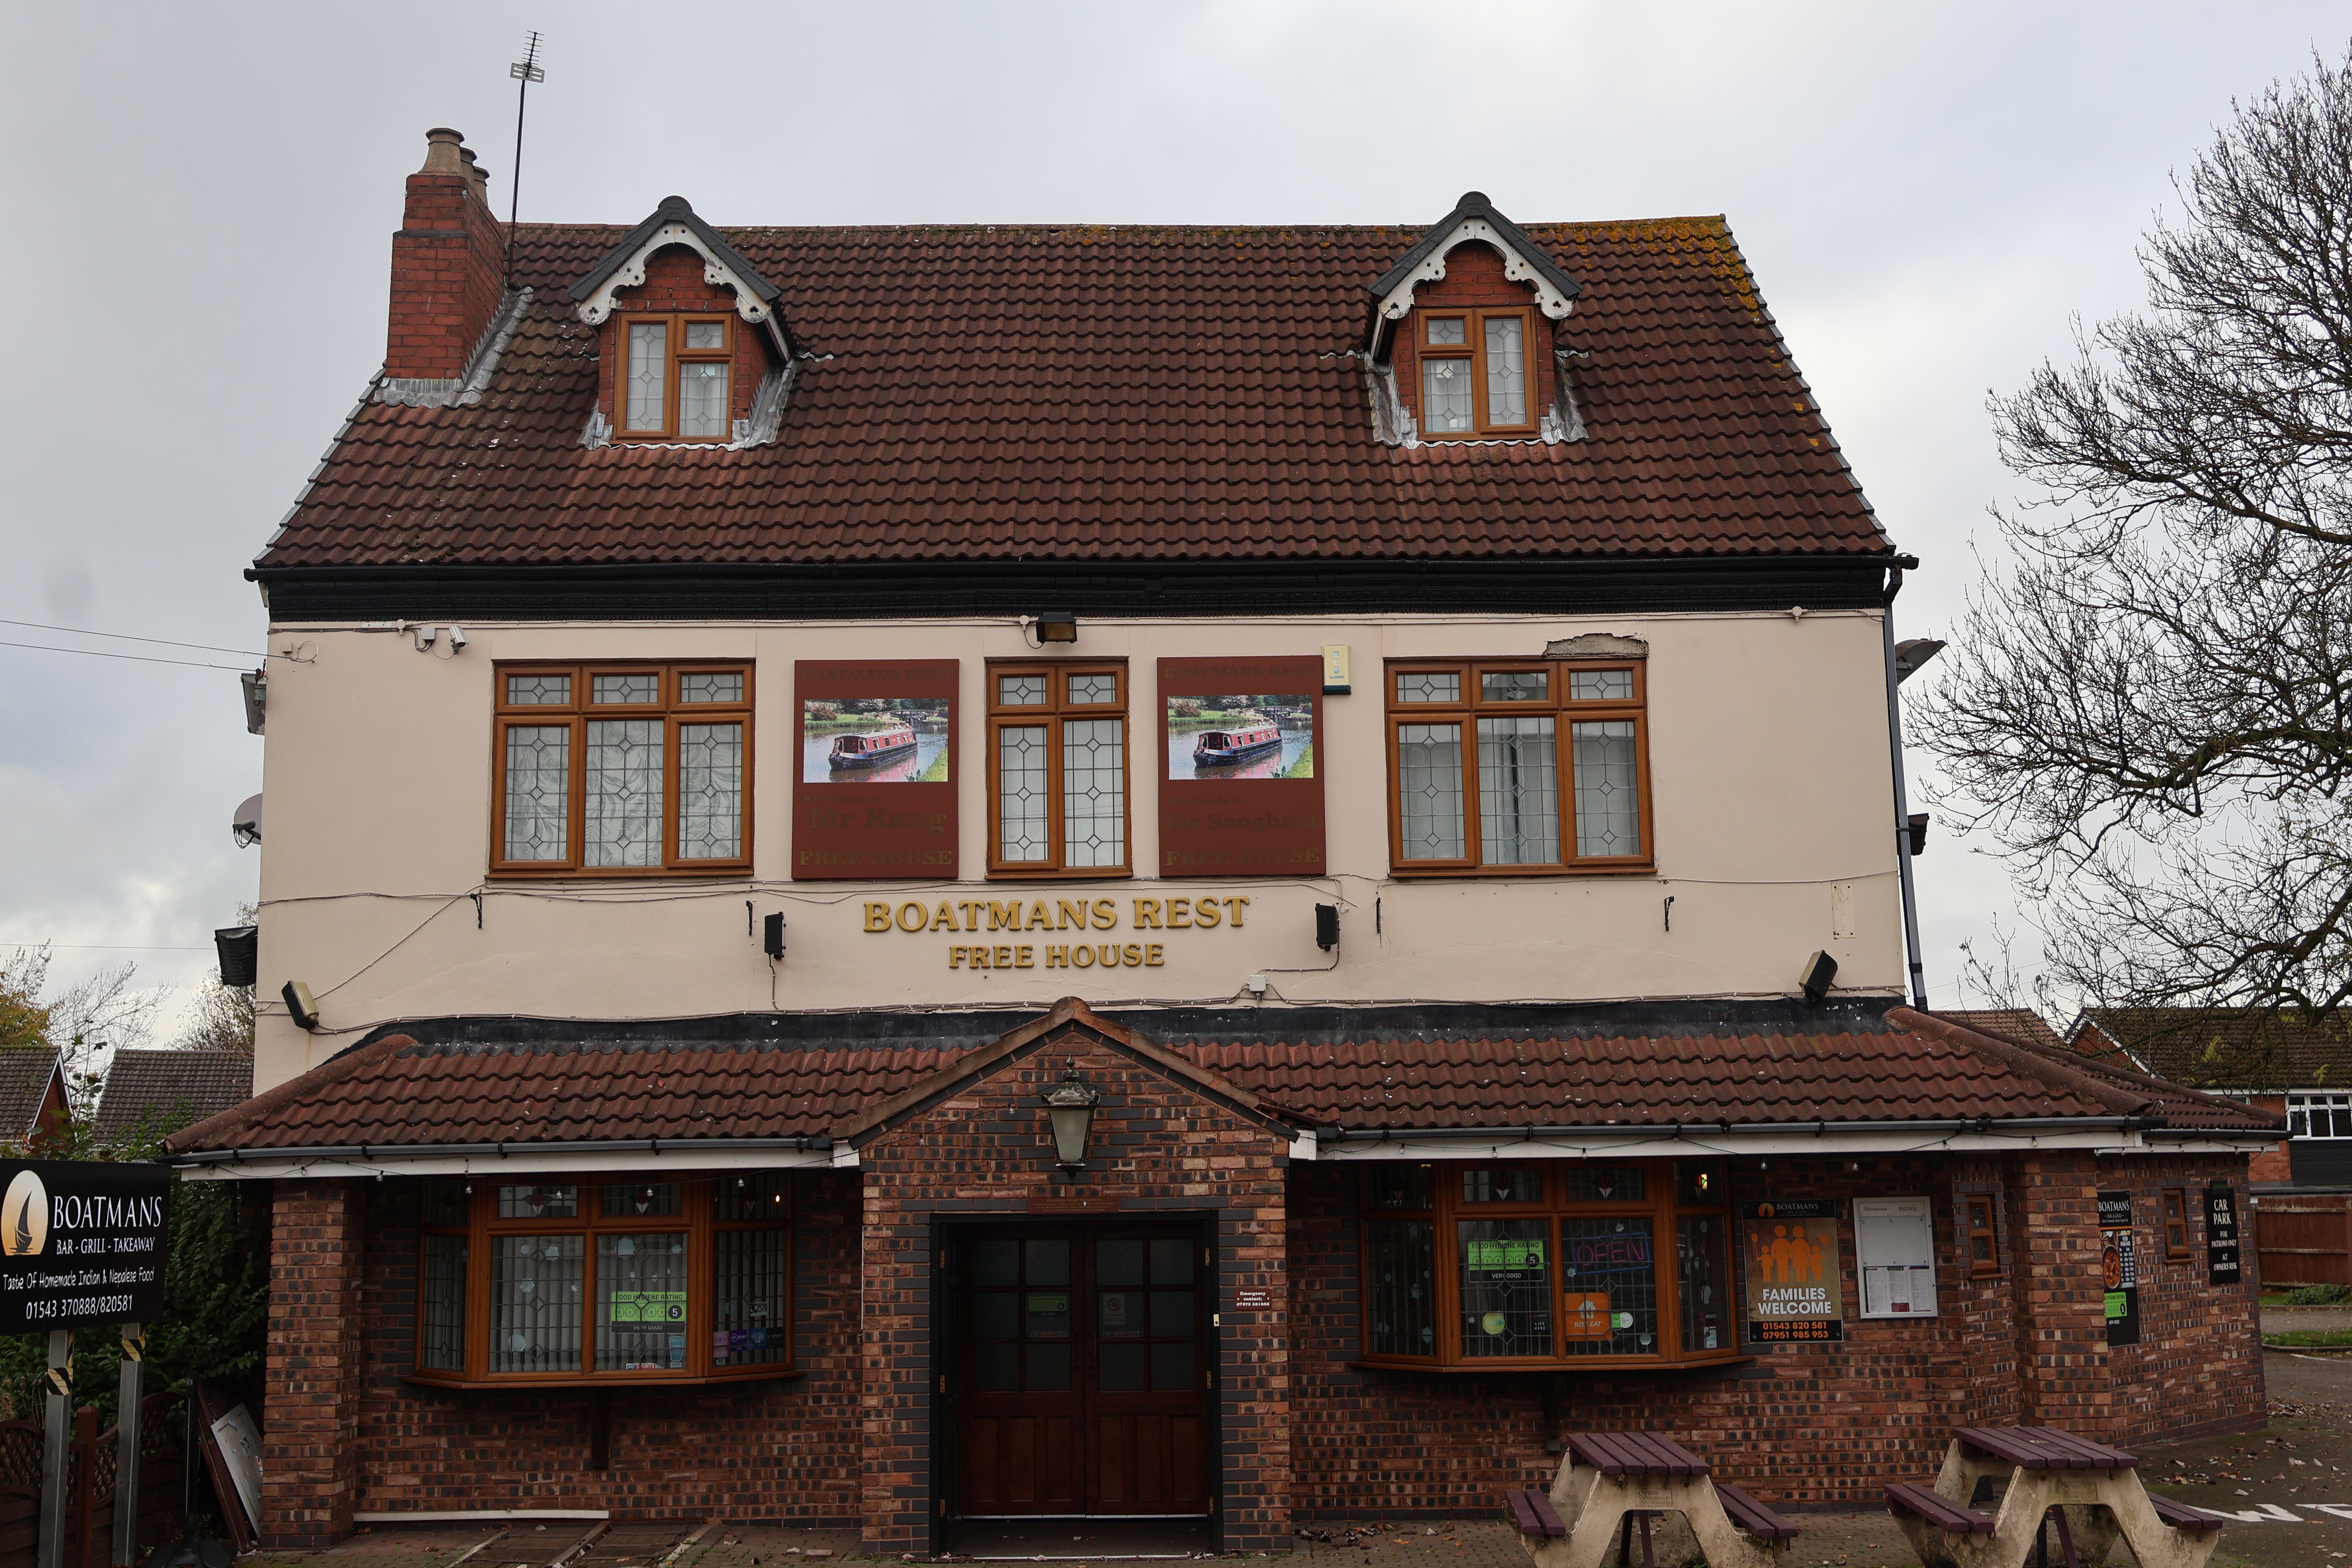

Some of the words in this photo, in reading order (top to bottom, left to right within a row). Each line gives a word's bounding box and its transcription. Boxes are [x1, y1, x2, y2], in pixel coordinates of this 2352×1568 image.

[800, 670, 899, 681] BOATMANS
[905, 669, 953, 681] REST
[1164, 666, 1263, 679] BOATMANS
[809, 808, 855, 828] Mr
[865, 808, 947, 834] Kang
[1166, 815, 1199, 829] Mr
[1207, 813, 1318, 832] Sanghera
[799, 851, 862, 865] FREE
[870, 850, 952, 865] HOUSE
[1166, 851, 1229, 865] FREE
[1238, 848, 1319, 864] HOUSE
[864, 898, 1117, 932] BOATMANS
[1133, 896, 1250, 928] REST
[949, 944, 1034, 969] FREE
[1045, 942, 1164, 968] HOUSE
[53, 1196, 162, 1229] BOATMANS
[2098, 1200, 2129, 1212] BOATMANS
[2214, 1199, 2228, 1211] CAR
[2214, 1212, 2231, 1225] PARK
[56, 1239, 74, 1254] BAR
[81, 1238, 106, 1254] GRILL
[113, 1237, 155, 1253] TAKEAWAY
[2212, 1240, 2227, 1248] PATRONS
[1577, 1240, 1644, 1266] OPEN
[2214, 1263, 2228, 1271] OWNERS
[2229, 1262, 2237, 1270] RISK
[3, 1274, 24, 1290] Taste
[27, 1272, 37, 1289] Of
[39, 1270, 76, 1288] Homemade
[78, 1269, 100, 1286] Indian
[102, 1269, 107, 1283] &
[110, 1269, 136, 1288] Nepalese
[139, 1266, 154, 1282] Food
[1762, 1287, 1826, 1301] FAMILIES
[26, 1300, 57, 1319] 01543
[61, 1294, 132, 1316] 370888/820581
[1758, 1301, 1831, 1315] WELCOME
[1763, 1322, 1789, 1330] 01543
